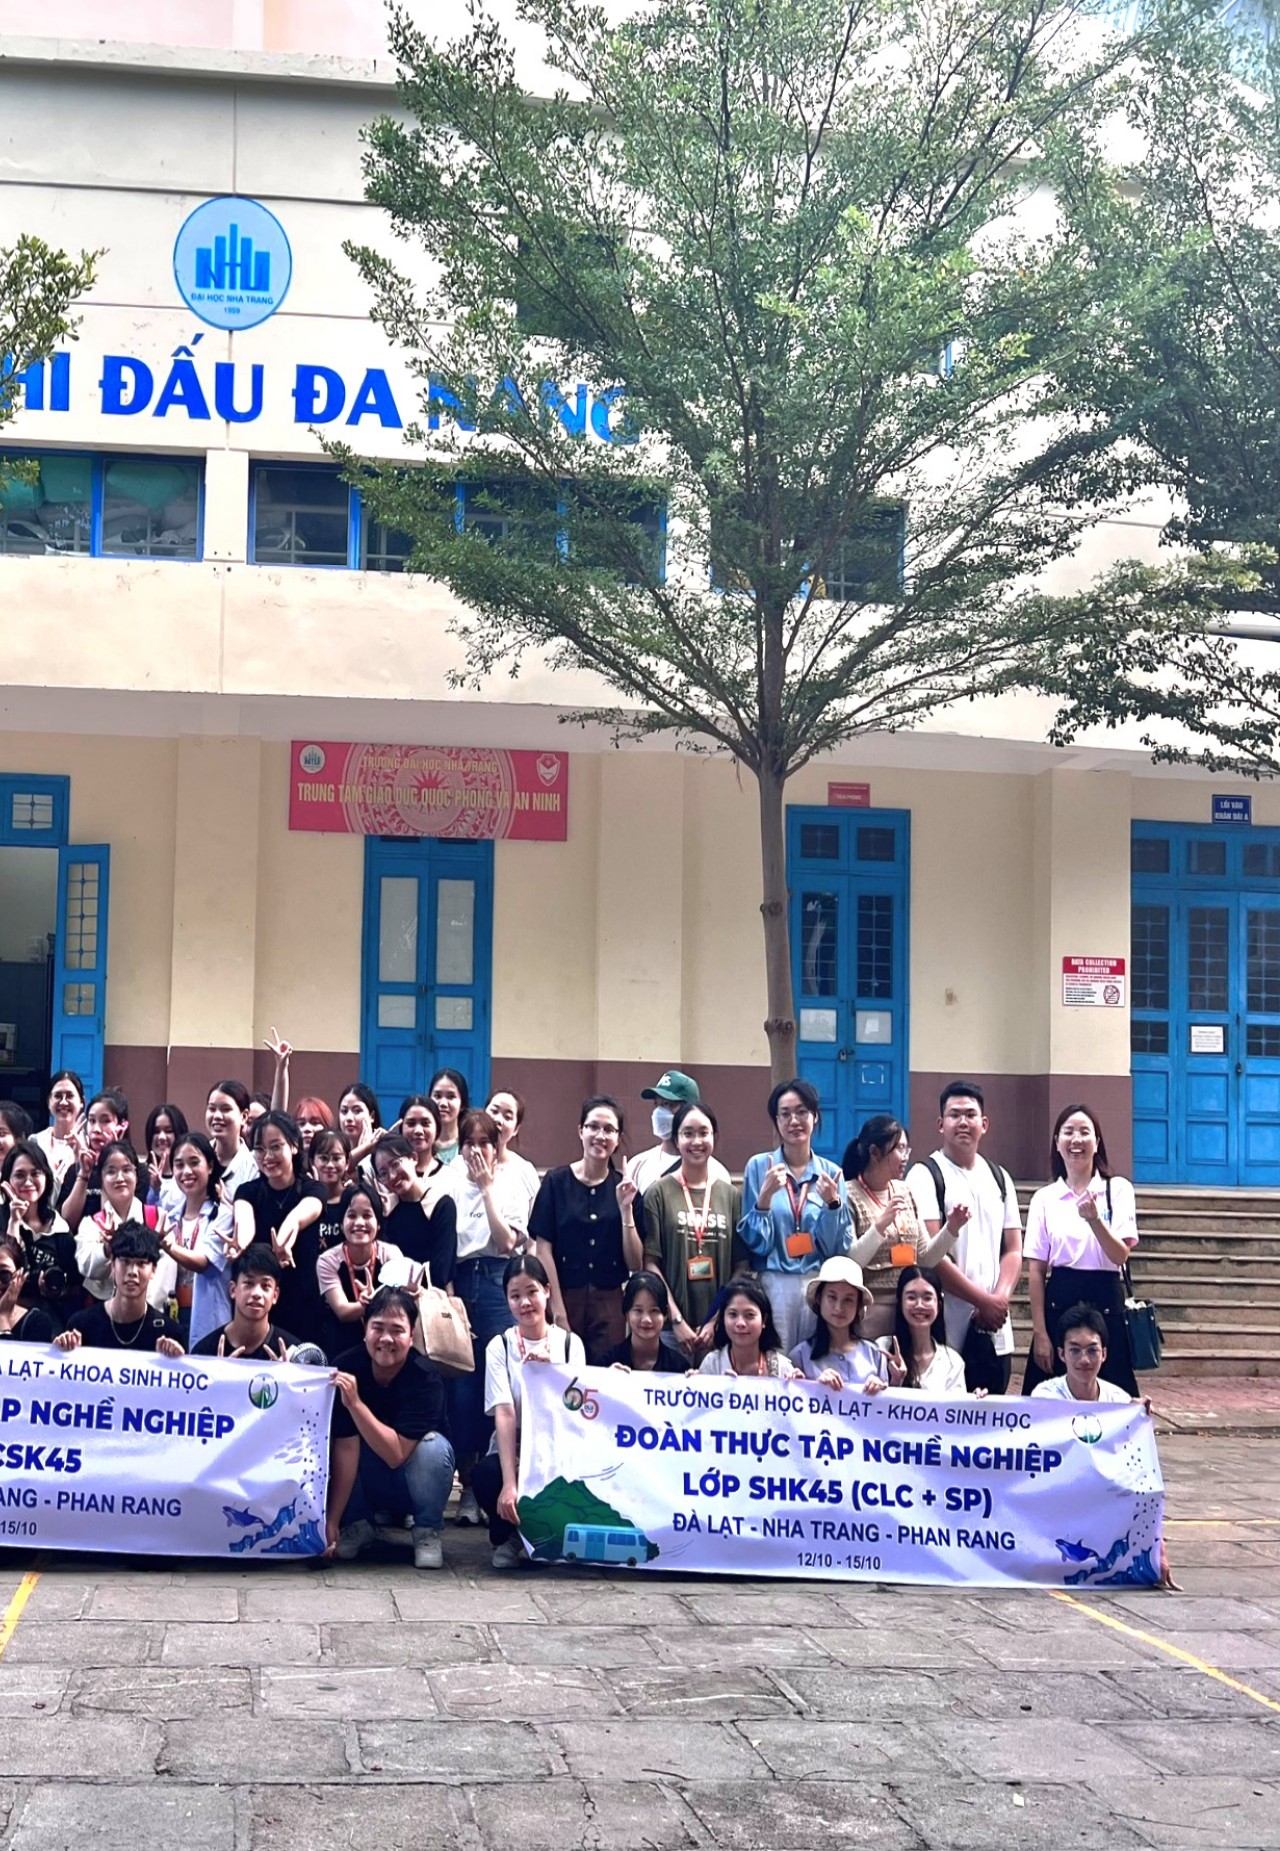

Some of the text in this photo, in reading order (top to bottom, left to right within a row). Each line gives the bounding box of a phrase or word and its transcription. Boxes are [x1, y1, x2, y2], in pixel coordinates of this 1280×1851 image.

[226, 294, 244, 303] NHA
[246, 295, 274, 305] TRANG
[98, 333, 264, 424] ĐẤU
[291, 363, 403, 429] ĐA
[298, 782, 335, 802] TRUNG
[514, 791, 530, 810] AN
[533, 793, 561, 811] NINH
[8, 1359, 44, 1382] LẠT
[60, 1363, 114, 1384] KHOA
[119, 1367, 163, 1387] SINH
[168, 1371, 209, 1394] HỌC
[30, 1396, 115, 1430] NGHỀ
[122, 1406, 235, 1445] NGHIỆP
[643, 1386, 724, 1409] TRƯỜNG
[729, 1393, 759, 1415] ĐẠI
[764, 1395, 803, 1417] HỌC
[808, 1394, 834, 1416] ĐÀ
[838, 1401, 872, 1421] LẠT
[887, 1404, 939, 1423] KHOA
[944, 1408, 987, 1426] SINH
[992, 1411, 1032, 1432] HỌC
[615, 1420, 1063, 1479] ĐOÀN THỰC TẬP NGHỀ NGHIỆP
[56, 1490, 115, 1513] PHAN
[121, 1495, 182, 1517] RANG
[683, 1467, 993, 1519] LỚP SHK45 (CLC + SP)
[0, 1520, 37, 1536] 15/10
[672, 1508, 702, 1533] ĐÀ
[707, 1514, 745, 1539] LẠT
[762, 1517, 805, 1539] NHA
[810, 1520, 880, 1543] TRANG
[897, 1525, 951, 1547] PHAN
[956, 1528, 1016, 1551] RANG
[797, 1552, 833, 1568] 12/10
[845, 1555, 881, 1570] 15/10
